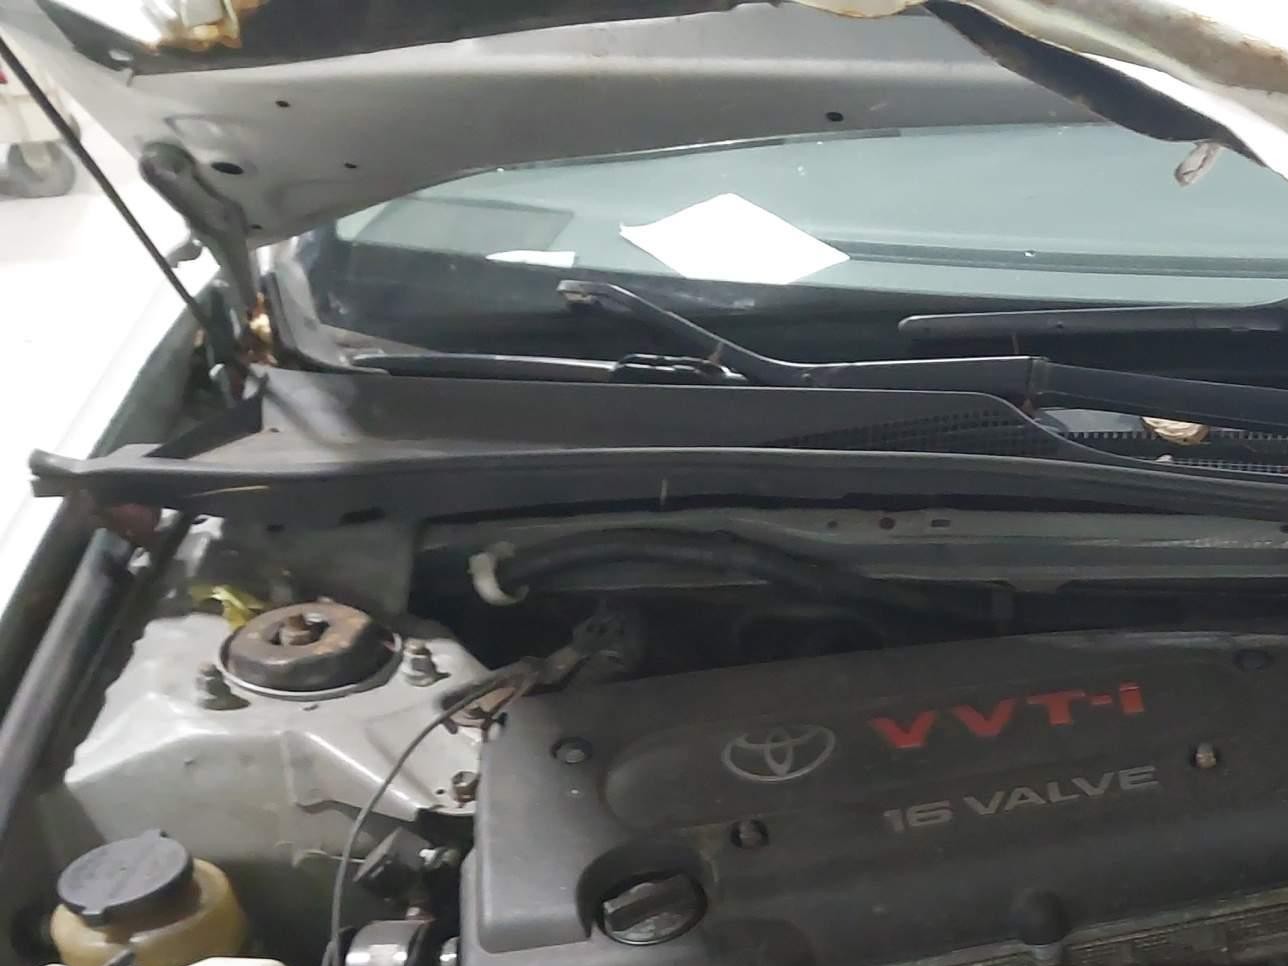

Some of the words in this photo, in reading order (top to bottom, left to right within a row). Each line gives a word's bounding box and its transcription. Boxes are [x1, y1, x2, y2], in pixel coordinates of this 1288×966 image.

[868, 679, 1145, 748] VVT-i
[884, 801, 952, 833] 16
[963, 765, 1160, 816] VALVE
